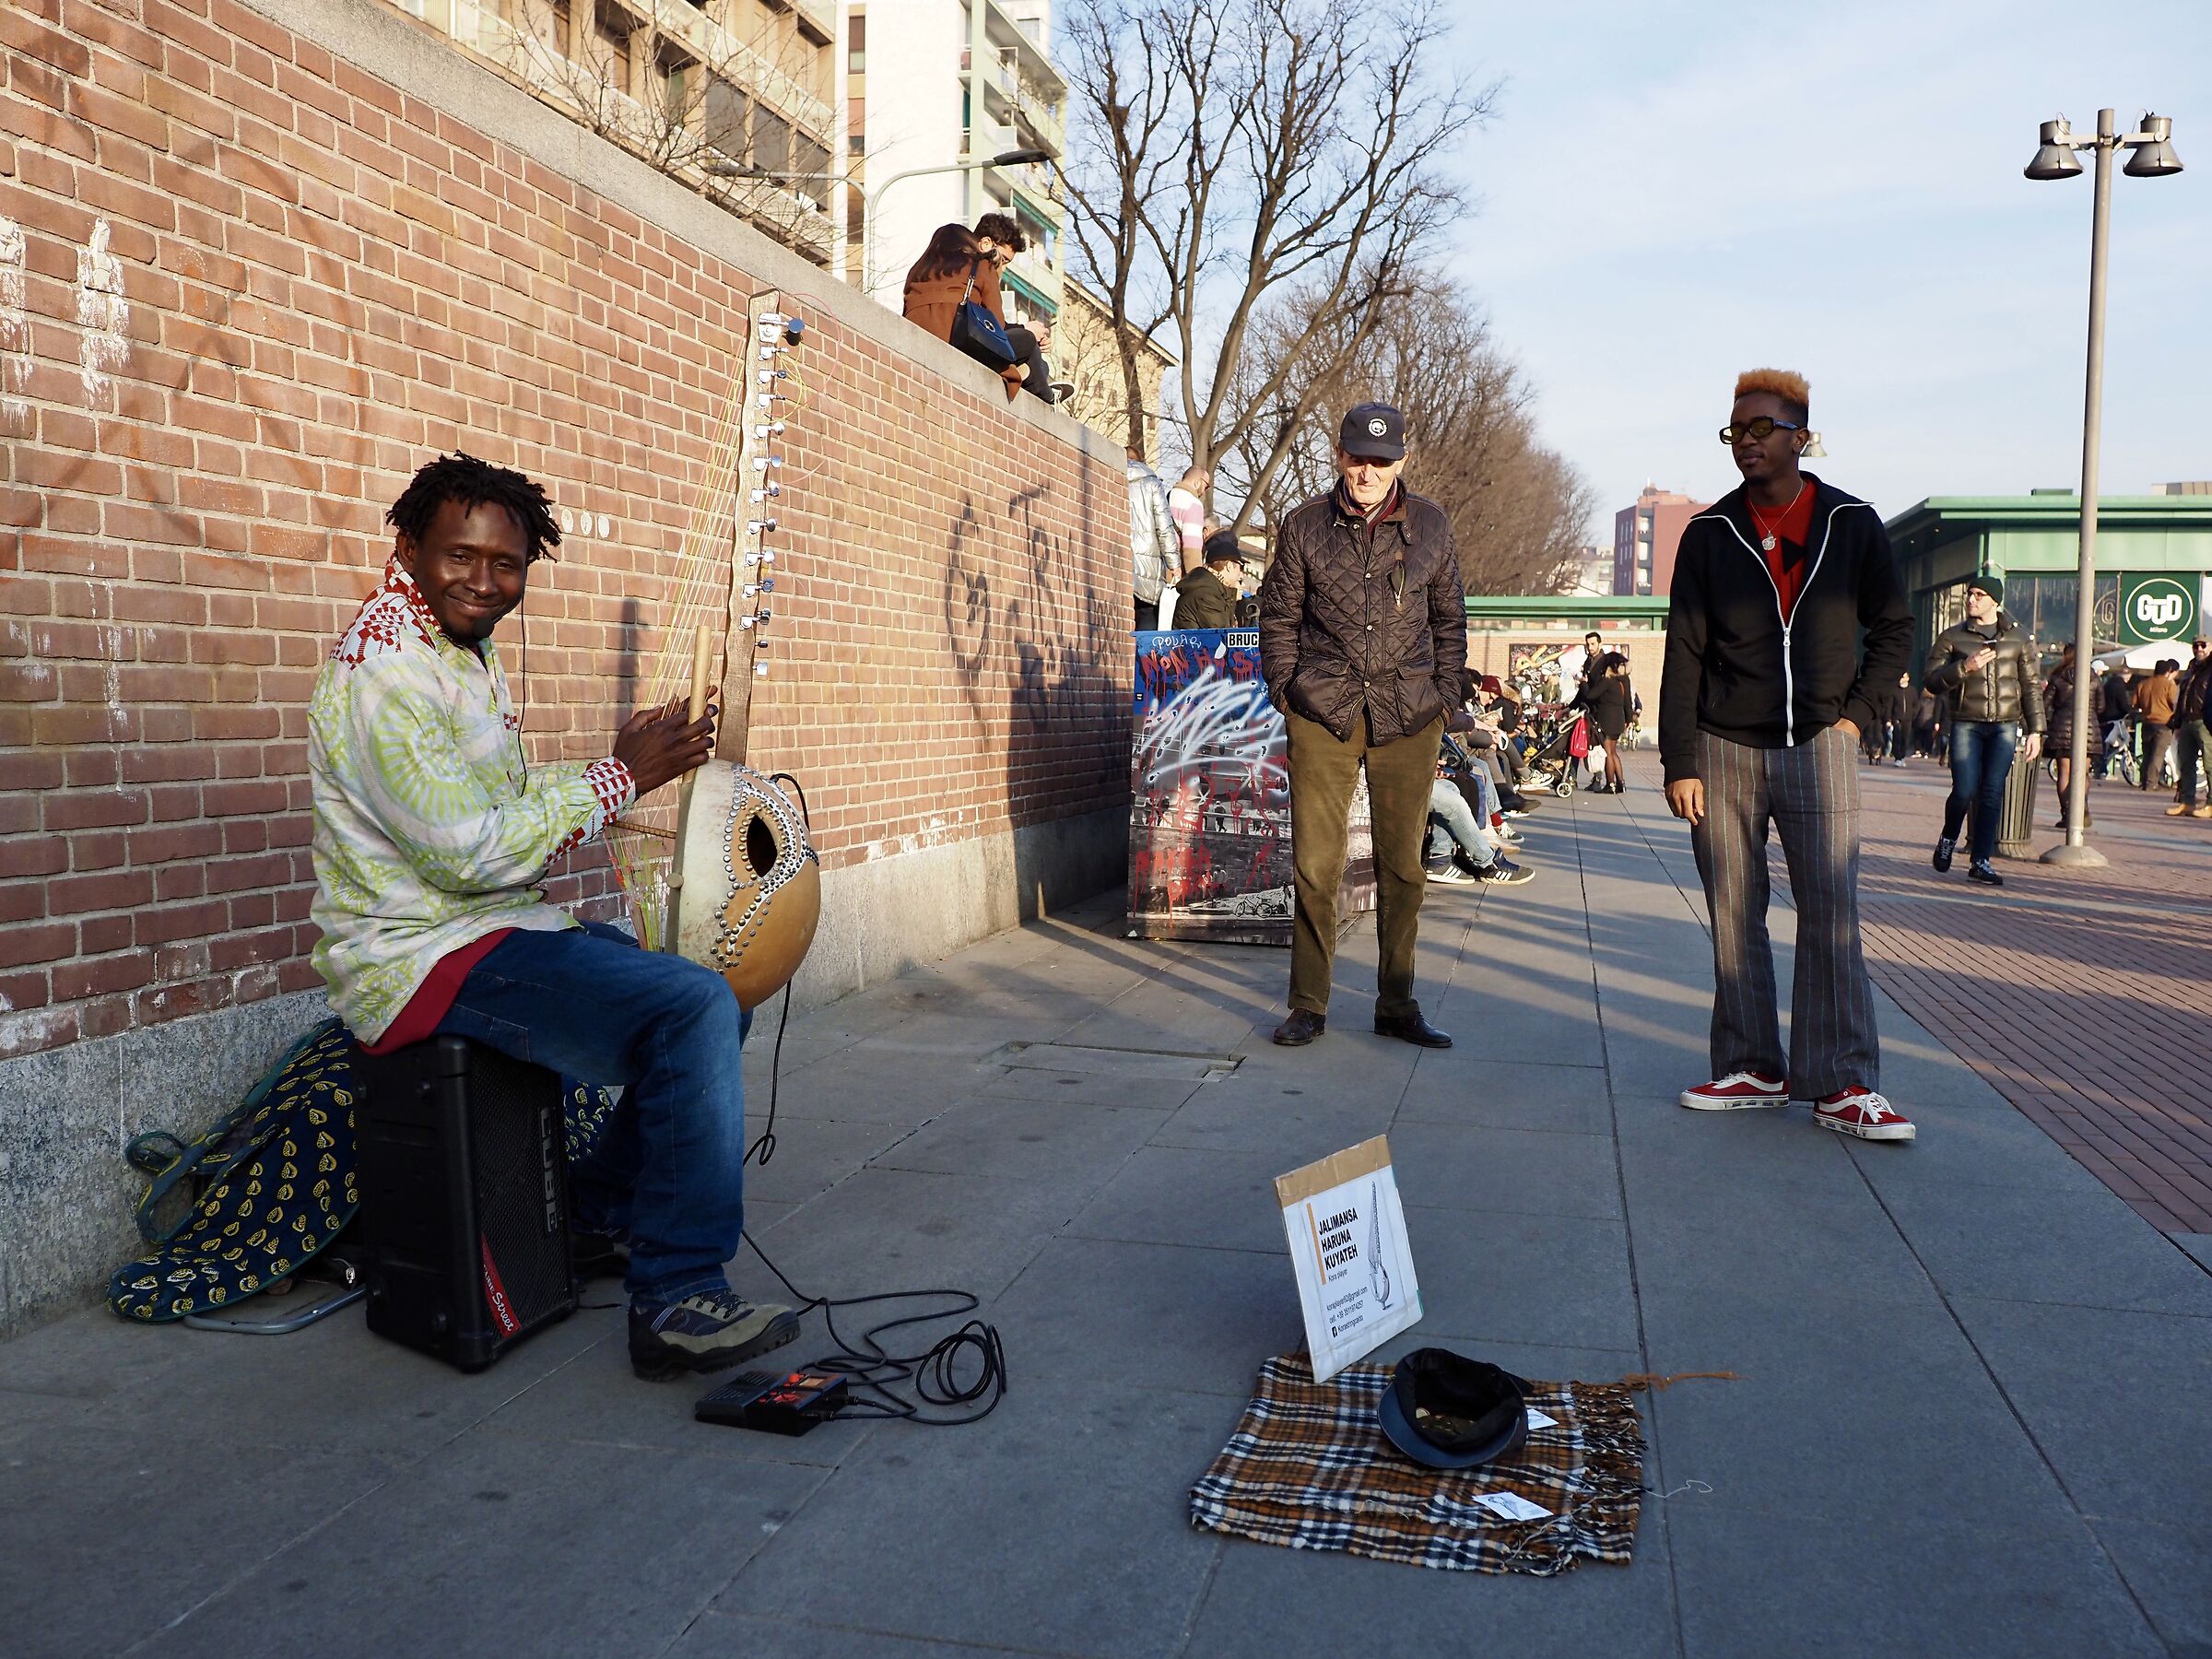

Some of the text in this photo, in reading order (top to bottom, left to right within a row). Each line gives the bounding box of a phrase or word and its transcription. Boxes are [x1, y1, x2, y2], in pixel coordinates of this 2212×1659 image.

[2136, 594, 2183, 625] GUD
[1229, 633, 1258, 646] BRUC
[538, 1107, 558, 1232] CUBE
[1319, 1207, 1359, 1236] JALIMANSA
[1321, 1229, 1352, 1253] HARUNA
[1324, 1244, 1359, 1271] KUYATEH
[492, 1292, 514, 1332] Street
